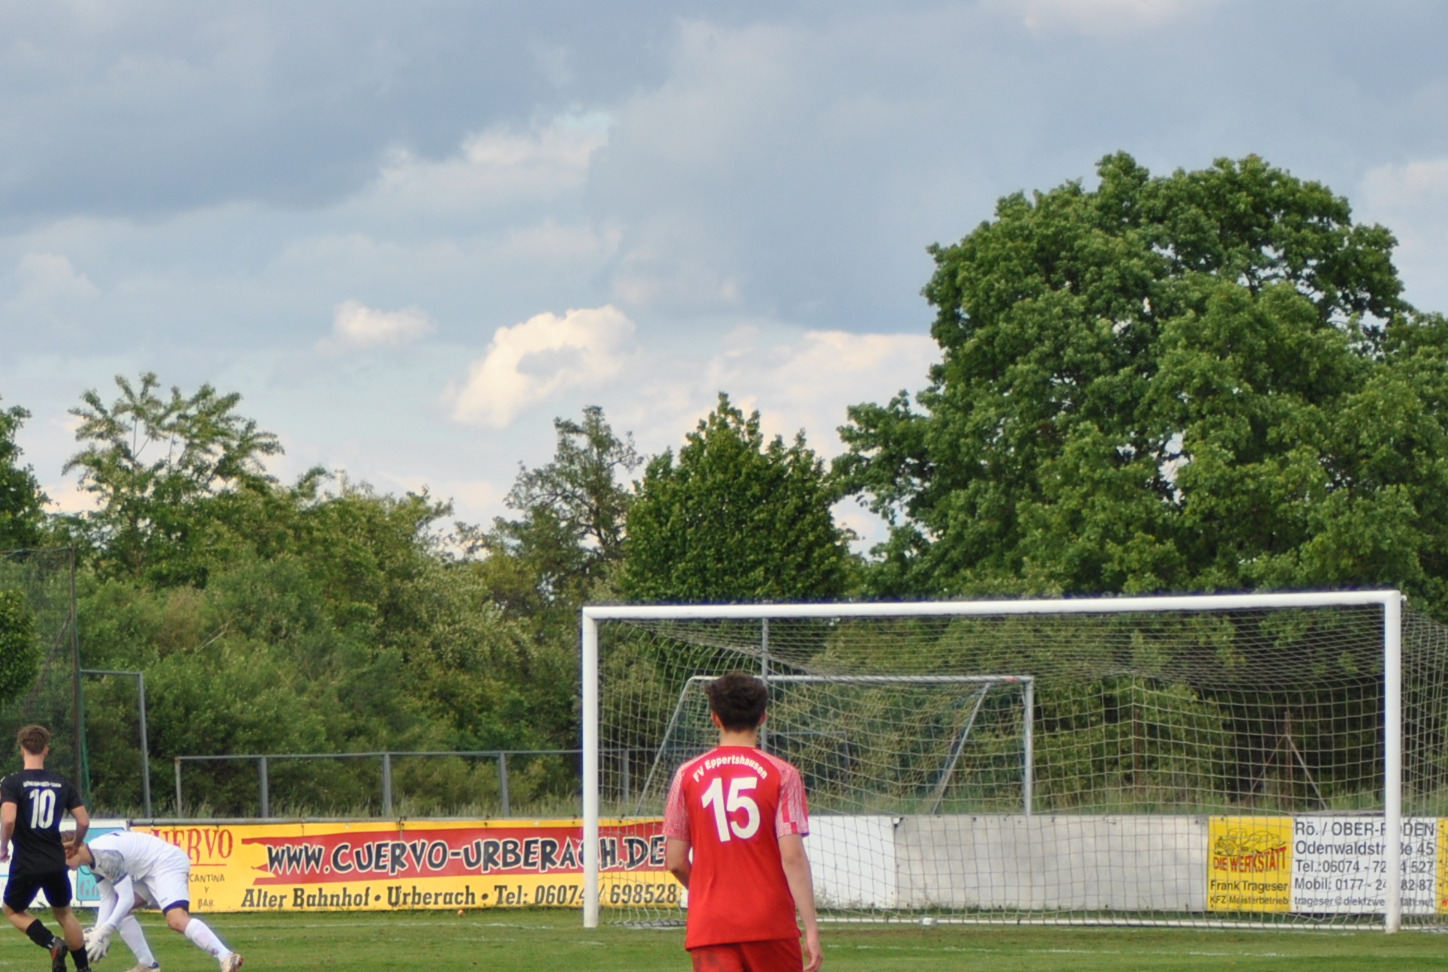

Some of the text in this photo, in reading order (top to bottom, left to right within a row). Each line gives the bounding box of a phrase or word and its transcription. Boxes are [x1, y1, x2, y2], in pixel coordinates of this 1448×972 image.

[693, 755, 768, 782] FV Eppertshausen
[29, 789, 56, 829] 10
[701, 777, 760, 842] 15
[1295, 821, 1319, 836] Rö.
[1331, 822, 1435, 837] OBER-DEN
[151, 828, 234, 864] ERVO
[1295, 841, 1434, 856] Odenwaldstre 45
[1213, 846, 1287, 873] DIE WERKSTATT
[1412, 860, 1435, 874] 527
[189, 873, 225, 883] CANTINA
[1210, 880, 1288, 893] Frank Trageser
[1295, 878, 1331, 890] Mobil:
[1336, 879, 1364, 890] 0177
[1419, 879, 1434, 891] 87
[241, 887, 287, 908] Alter
[292, 886, 371, 908] Bahnhof
[386, 884, 476, 907] Urberach
[610, 884, 678, 904] 698528
